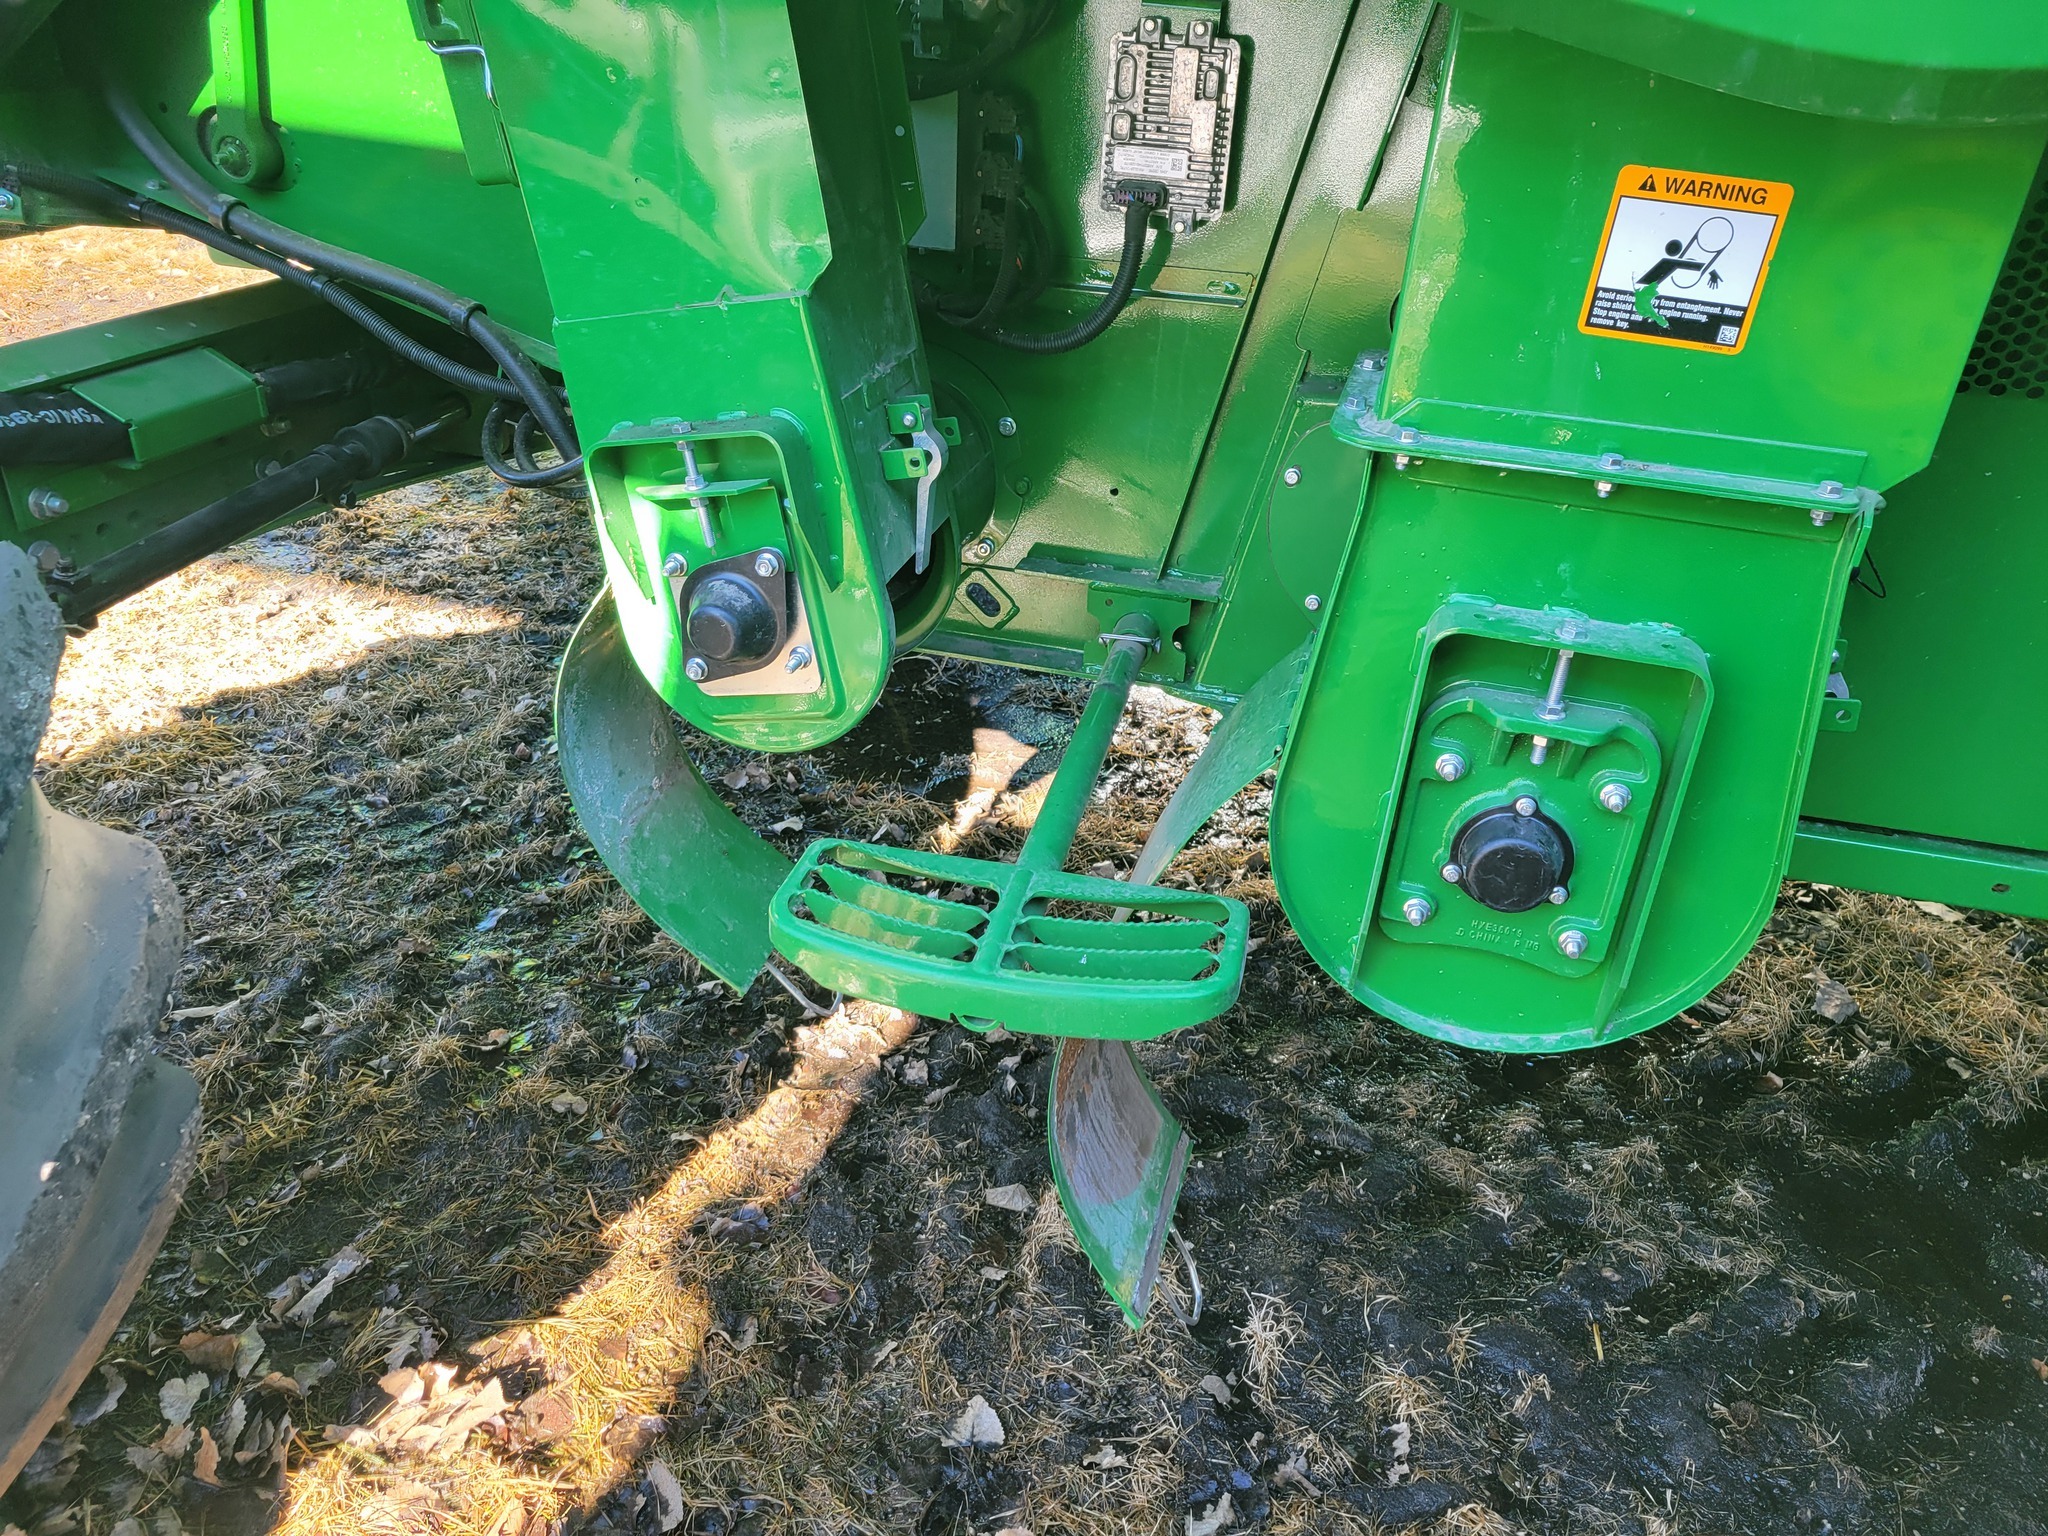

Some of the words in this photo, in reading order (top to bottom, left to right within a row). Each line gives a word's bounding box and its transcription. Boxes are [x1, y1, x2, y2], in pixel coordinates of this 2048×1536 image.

[1665, 176, 1768, 205] WARNING
[1593, 307, 1607, 317] Stop
[1608, 310, 1630, 319] engine
[1595, 300, 1611, 308] raise
[1612, 301, 1632, 311] shield
[1659, 308, 1681, 318] engine
[1682, 311, 1709, 323] running.
[1597, 290, 1616, 300] Avoid
[1660, 298, 1676, 308] from
[1676, 302, 1722, 314] entanglement.
[1723, 307, 1744, 317] Never
[1590, 317, 1614, 326] remove
[1616, 320, 1630, 329] key.
